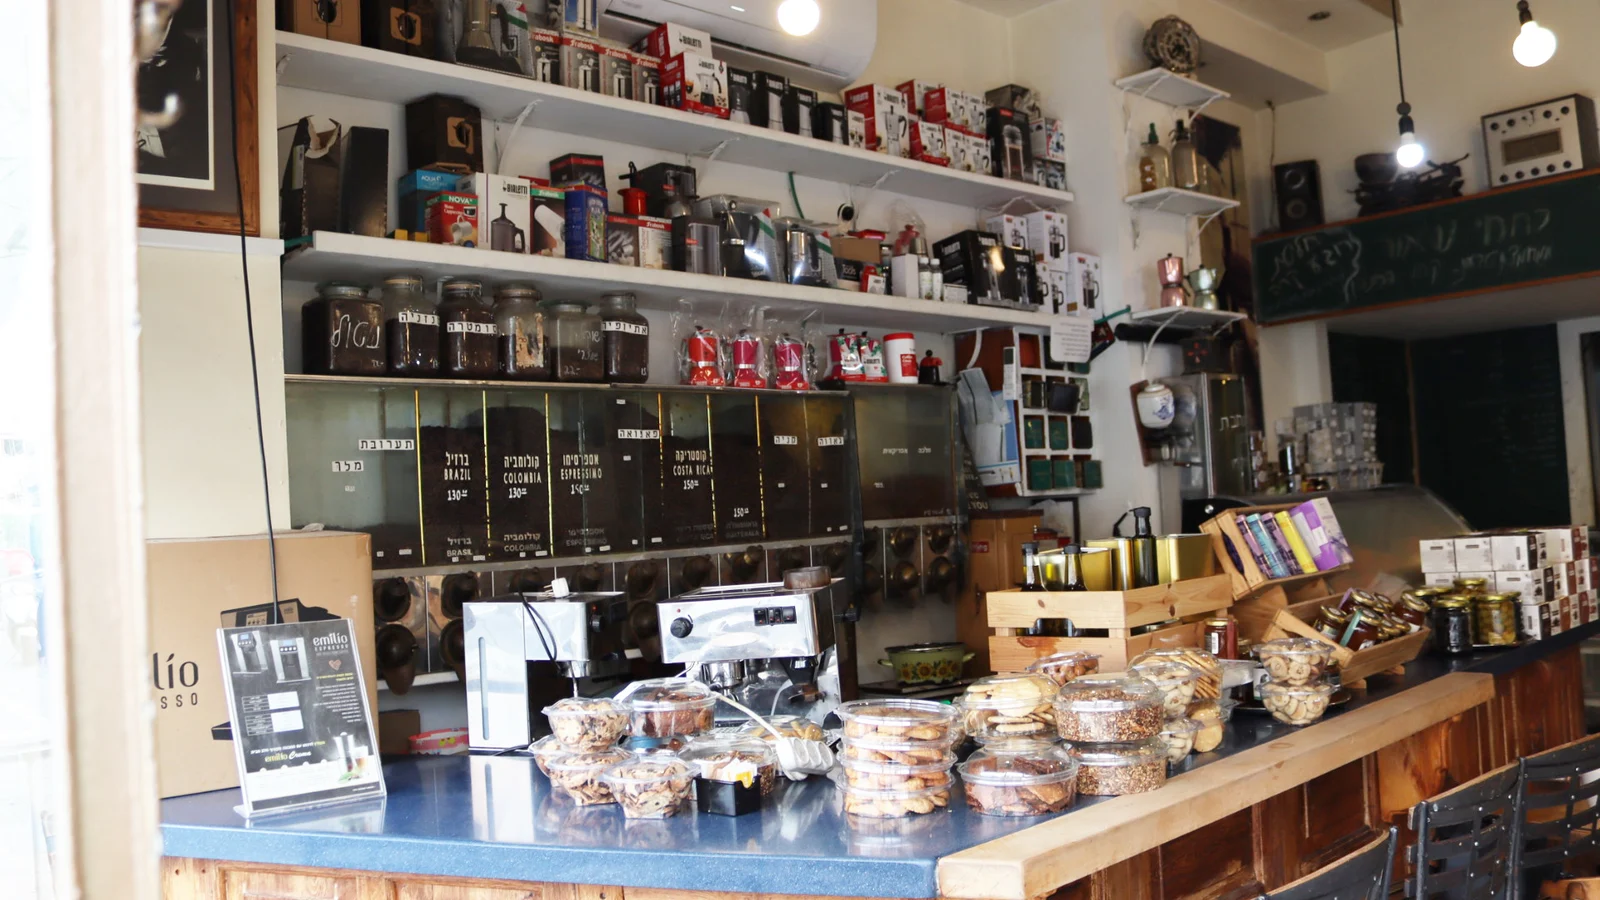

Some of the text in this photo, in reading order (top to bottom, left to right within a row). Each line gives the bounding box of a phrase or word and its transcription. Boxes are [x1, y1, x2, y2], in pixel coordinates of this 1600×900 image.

[506, 183, 528, 195] BIALETTI
[331, 314, 380, 349] נטול
[360, 440, 413, 449] תערובת
[445, 451, 469, 466] ברזיל
[504, 454, 540, 469] קולומביה
[334, 461, 362, 471] מלך
[673, 465, 711, 476] COSTA RICA
[444, 468, 471, 481] BRAZIL
[503, 472, 542, 484] COLOMBIA
